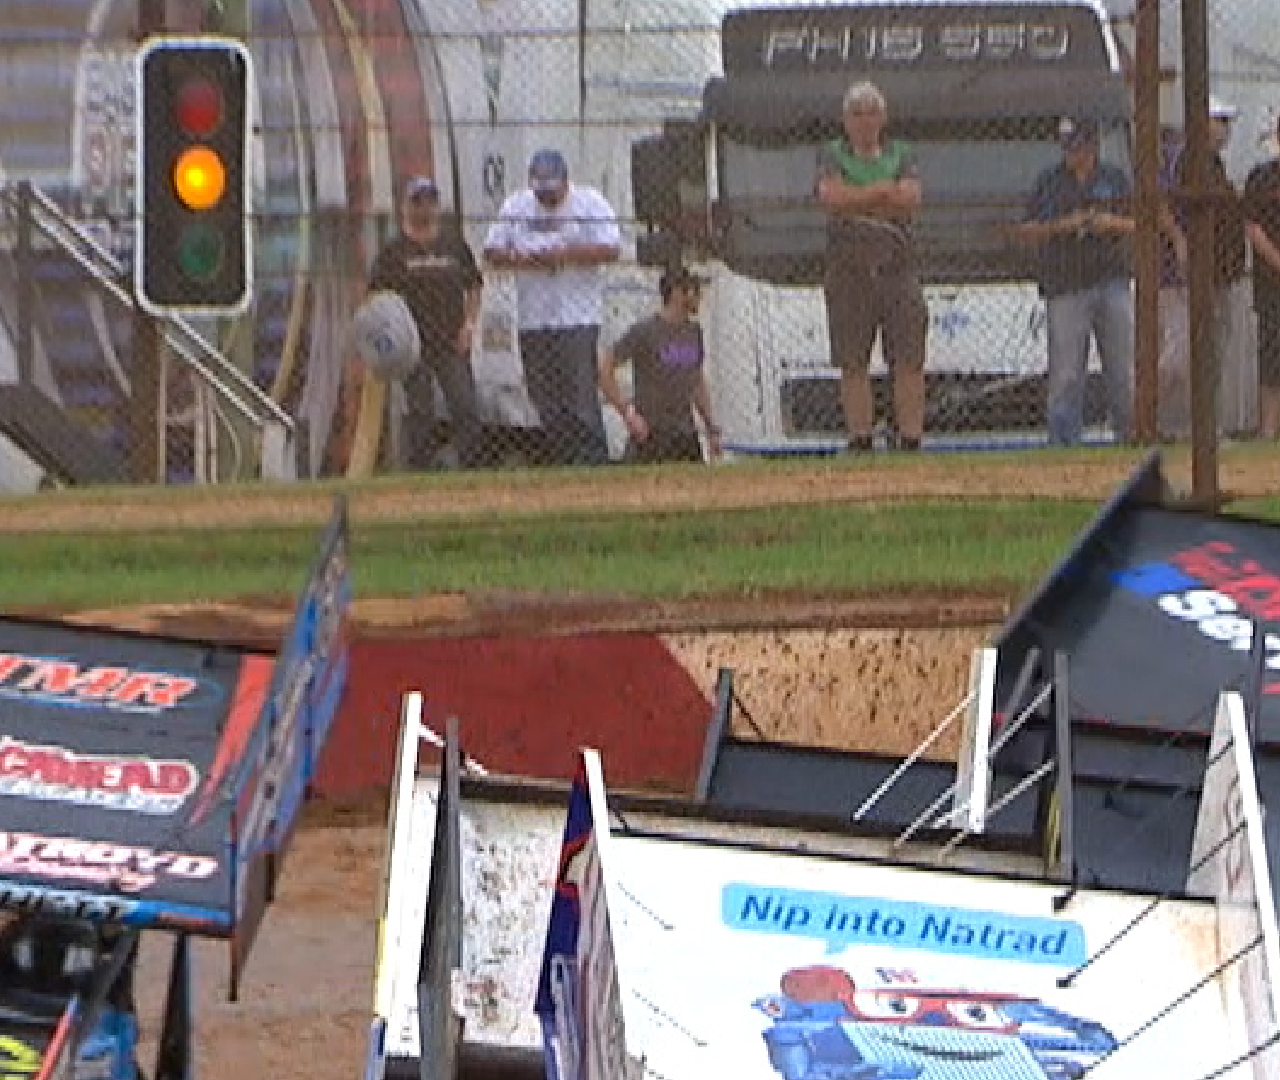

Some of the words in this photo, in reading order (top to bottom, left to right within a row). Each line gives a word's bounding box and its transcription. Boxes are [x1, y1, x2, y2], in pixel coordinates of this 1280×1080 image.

[740, 893, 811, 931] Nip
[825, 902, 906, 938] into
[919, 913, 1068, 957] Natrad
